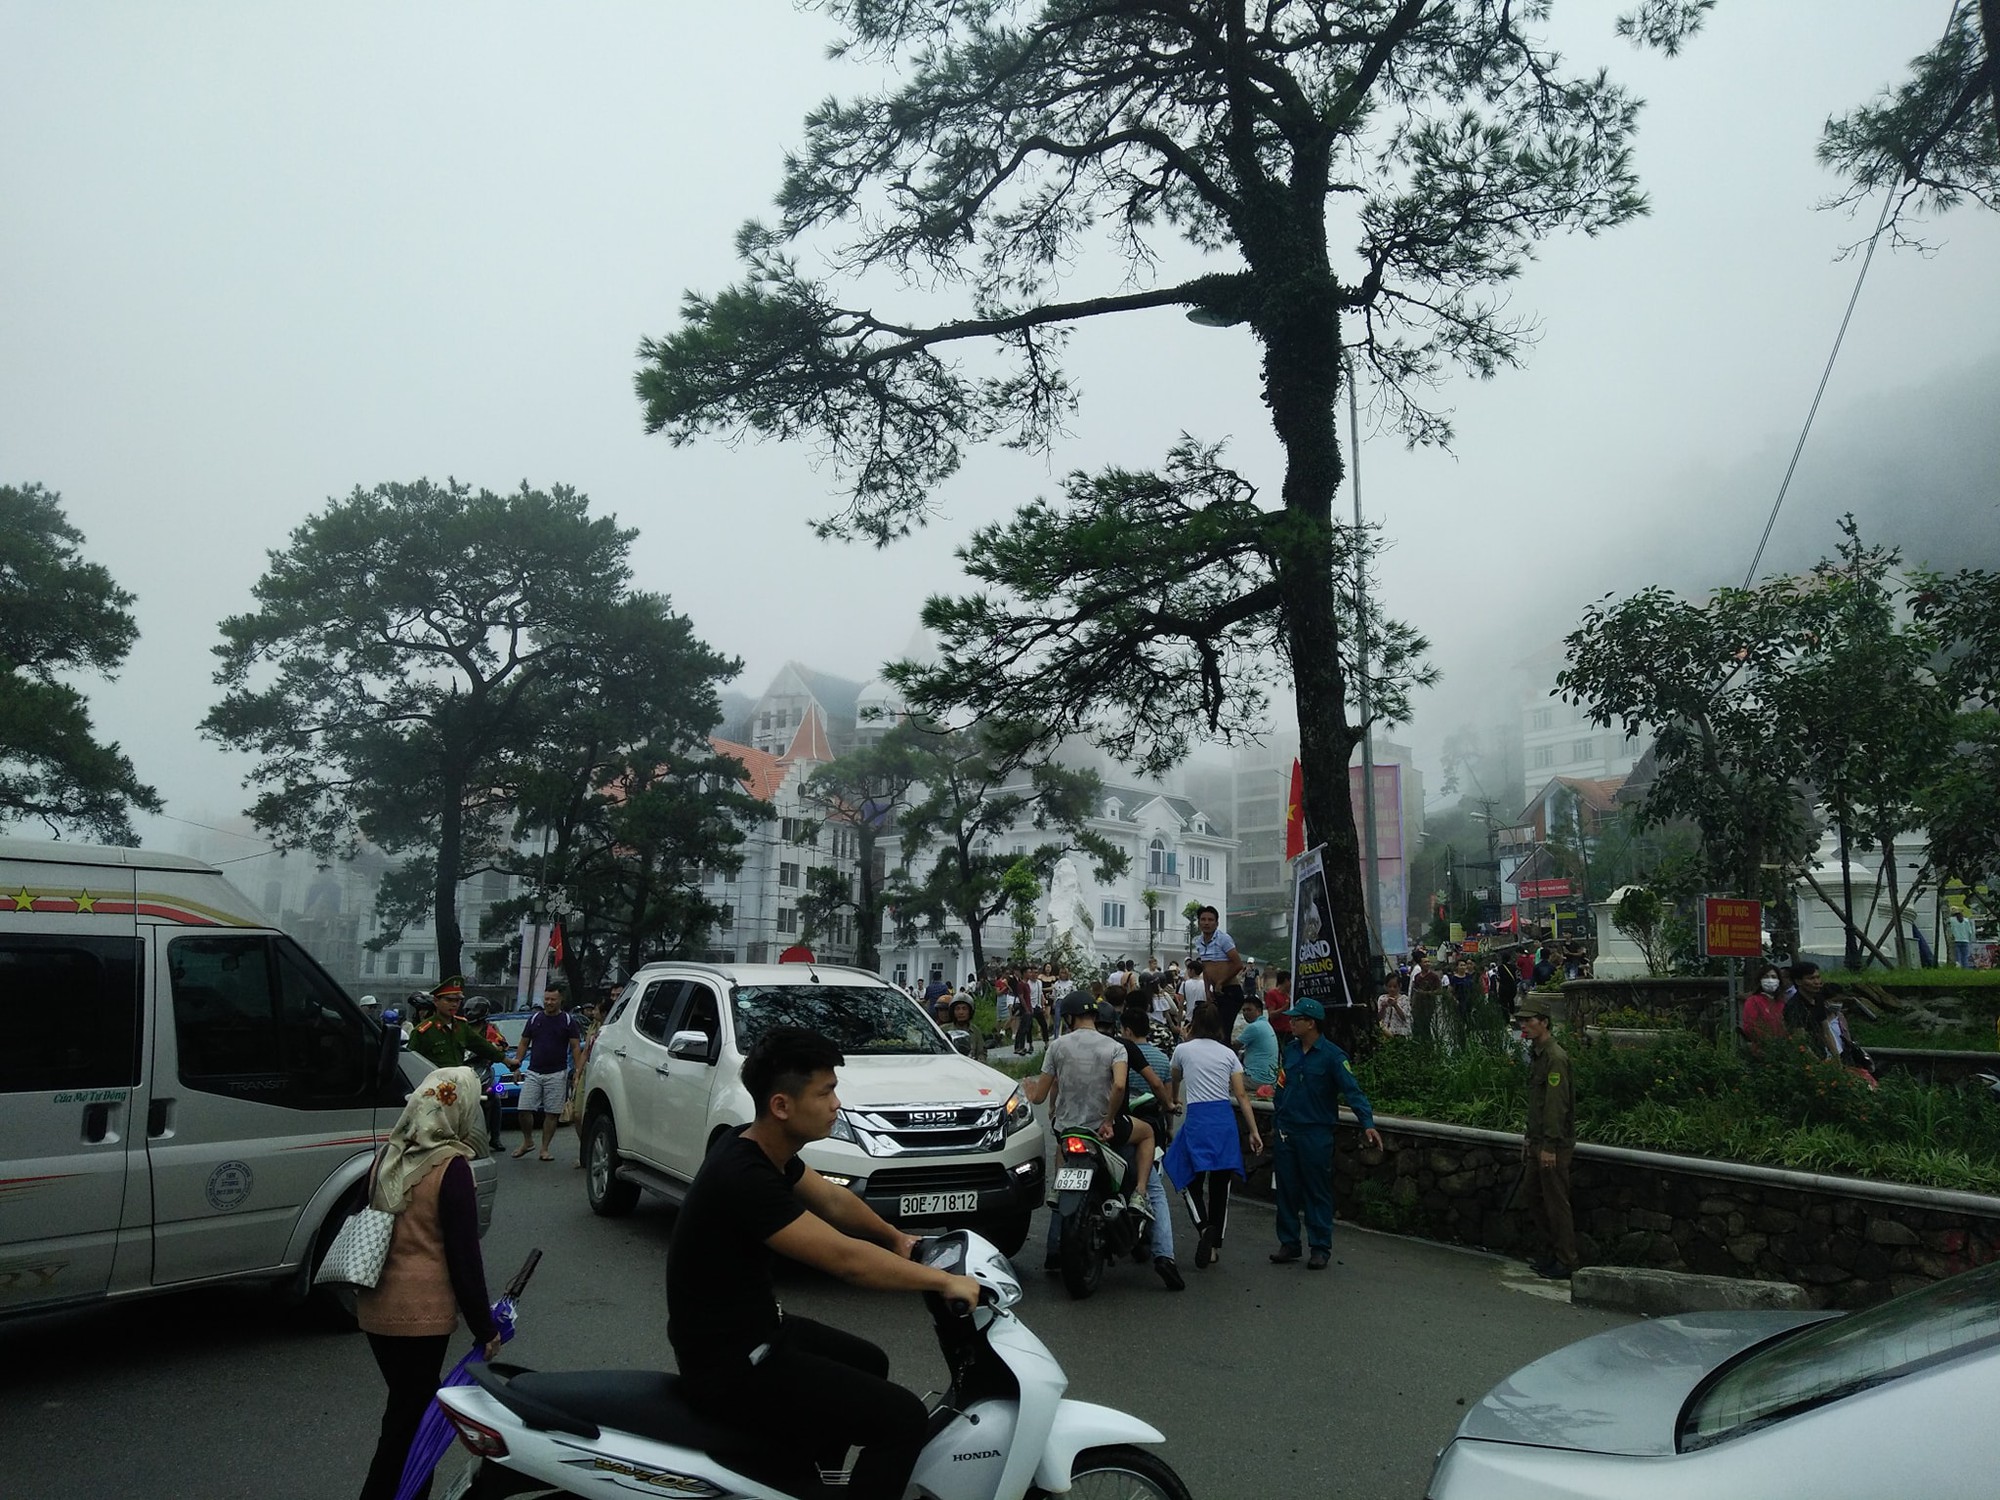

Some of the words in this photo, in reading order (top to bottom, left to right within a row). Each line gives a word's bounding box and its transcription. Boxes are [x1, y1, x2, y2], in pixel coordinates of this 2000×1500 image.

[227, 1079, 289, 1091] TRANSIT
[909, 1111, 958, 1123] ISUZU
[953, 1450, 1002, 1462] HONDA
